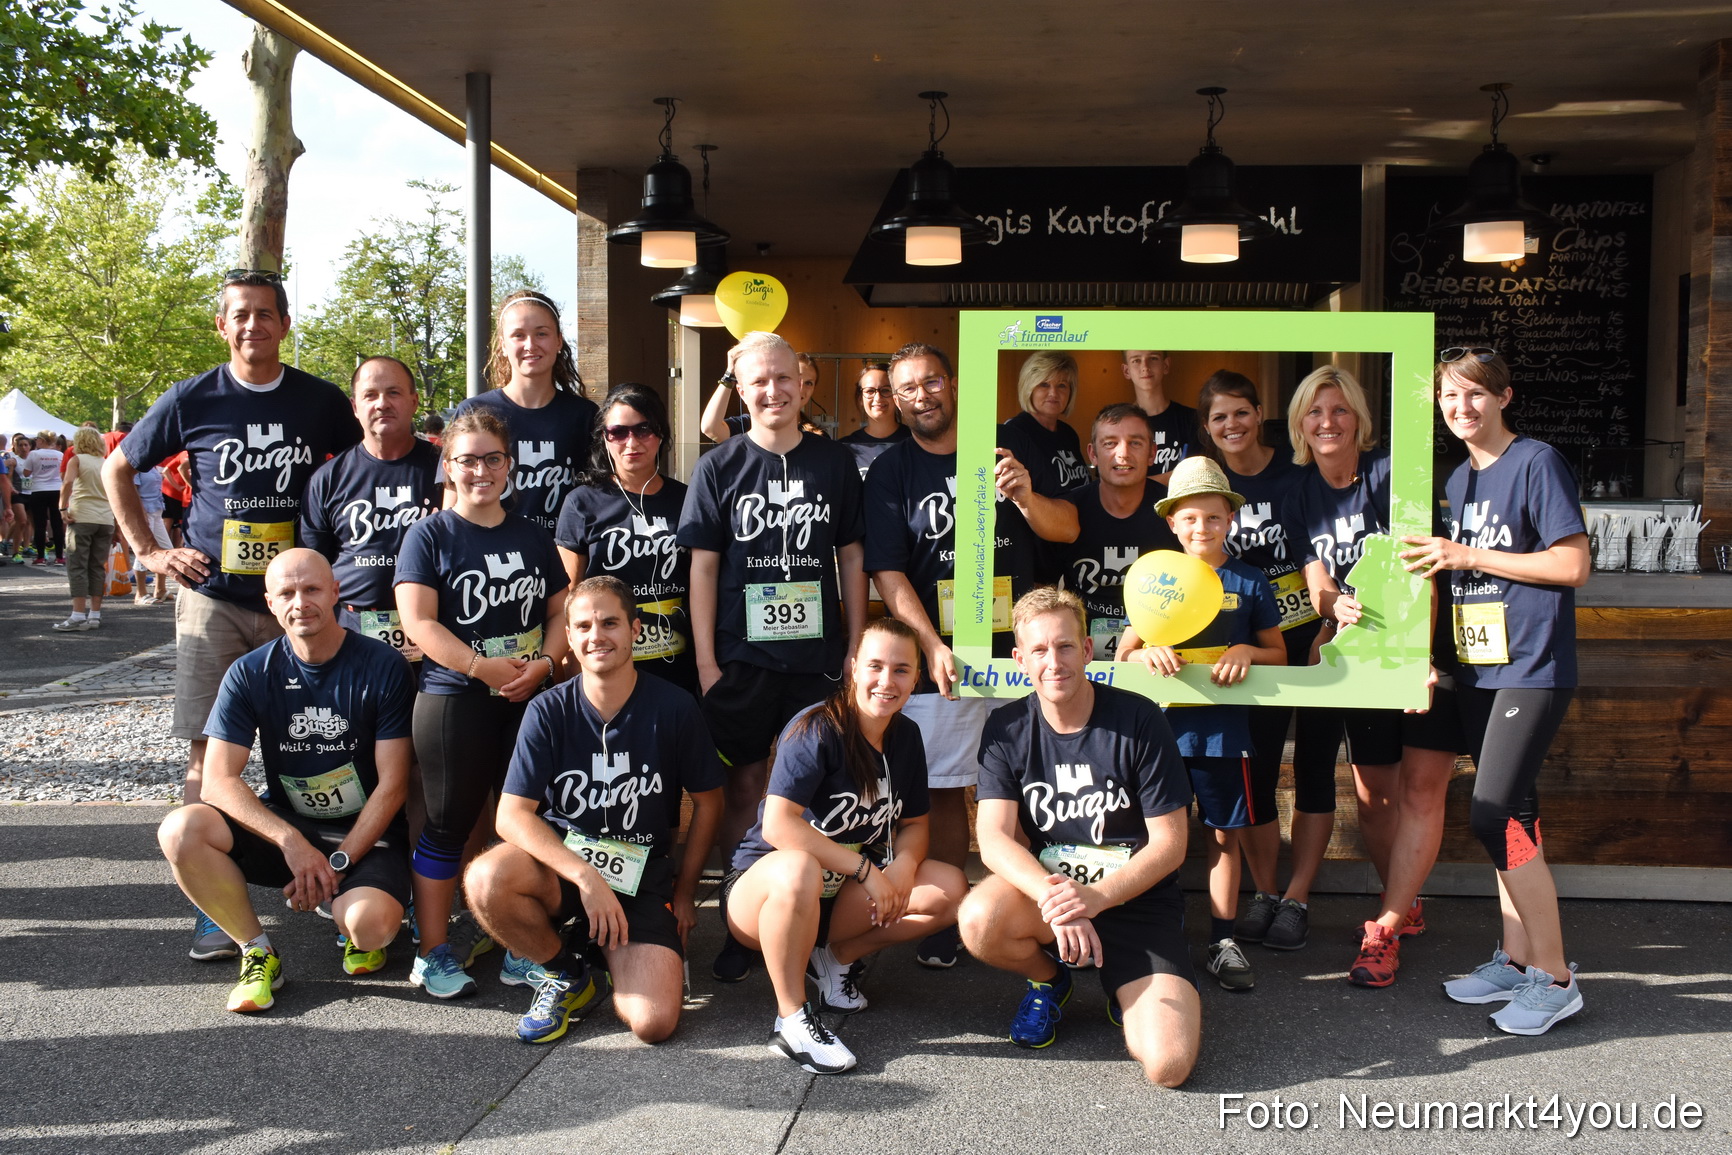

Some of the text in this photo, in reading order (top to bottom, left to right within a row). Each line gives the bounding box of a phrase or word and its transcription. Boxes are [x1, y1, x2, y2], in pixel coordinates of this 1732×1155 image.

[1047, 200, 1172, 244] Kartoff
[1550, 201, 1646, 224] KARTOFFEL
[1552, 223, 1627, 254] Chips
[1547, 265, 1566, 278] XL
[742, 281, 774, 301] Burgis
[1418, 296, 1469, 310] Topping
[1472, 295, 1504, 306] nach
[1508, 293, 1547, 306] Wahl
[1020, 330, 1089, 343] firmenlauf
[1514, 337, 1601, 353] Räucherlachs
[212, 436, 313, 493] Burgis
[736, 493, 831, 551] Burgis
[237, 541, 280, 560] 385
[974, 466, 987, 625] www.firmenlauf-oberpfalz.de
[452, 567, 546, 627] Burgis
[633, 583, 685, 597] ödelliebe
[1137, 573, 1186, 610] Burgis
[763, 603, 807, 624] 393
[1087, 600, 1127, 616] Knödel
[1459, 625, 1489, 647] 394
[961, 665, 998, 687] Ich
[1005, 671, 1035, 688] wa
[288, 712, 349, 741] Burgis
[279, 741, 311, 753] Weil's
[315, 739, 347, 754] guad
[300, 787, 344, 808] 391
[553, 763, 663, 831] Burgis
[1022, 779, 1132, 846] Burgis
[581, 847, 626, 876] 396
[599, 869, 624, 884] Thomas
[1057, 862, 1105, 886] 384
